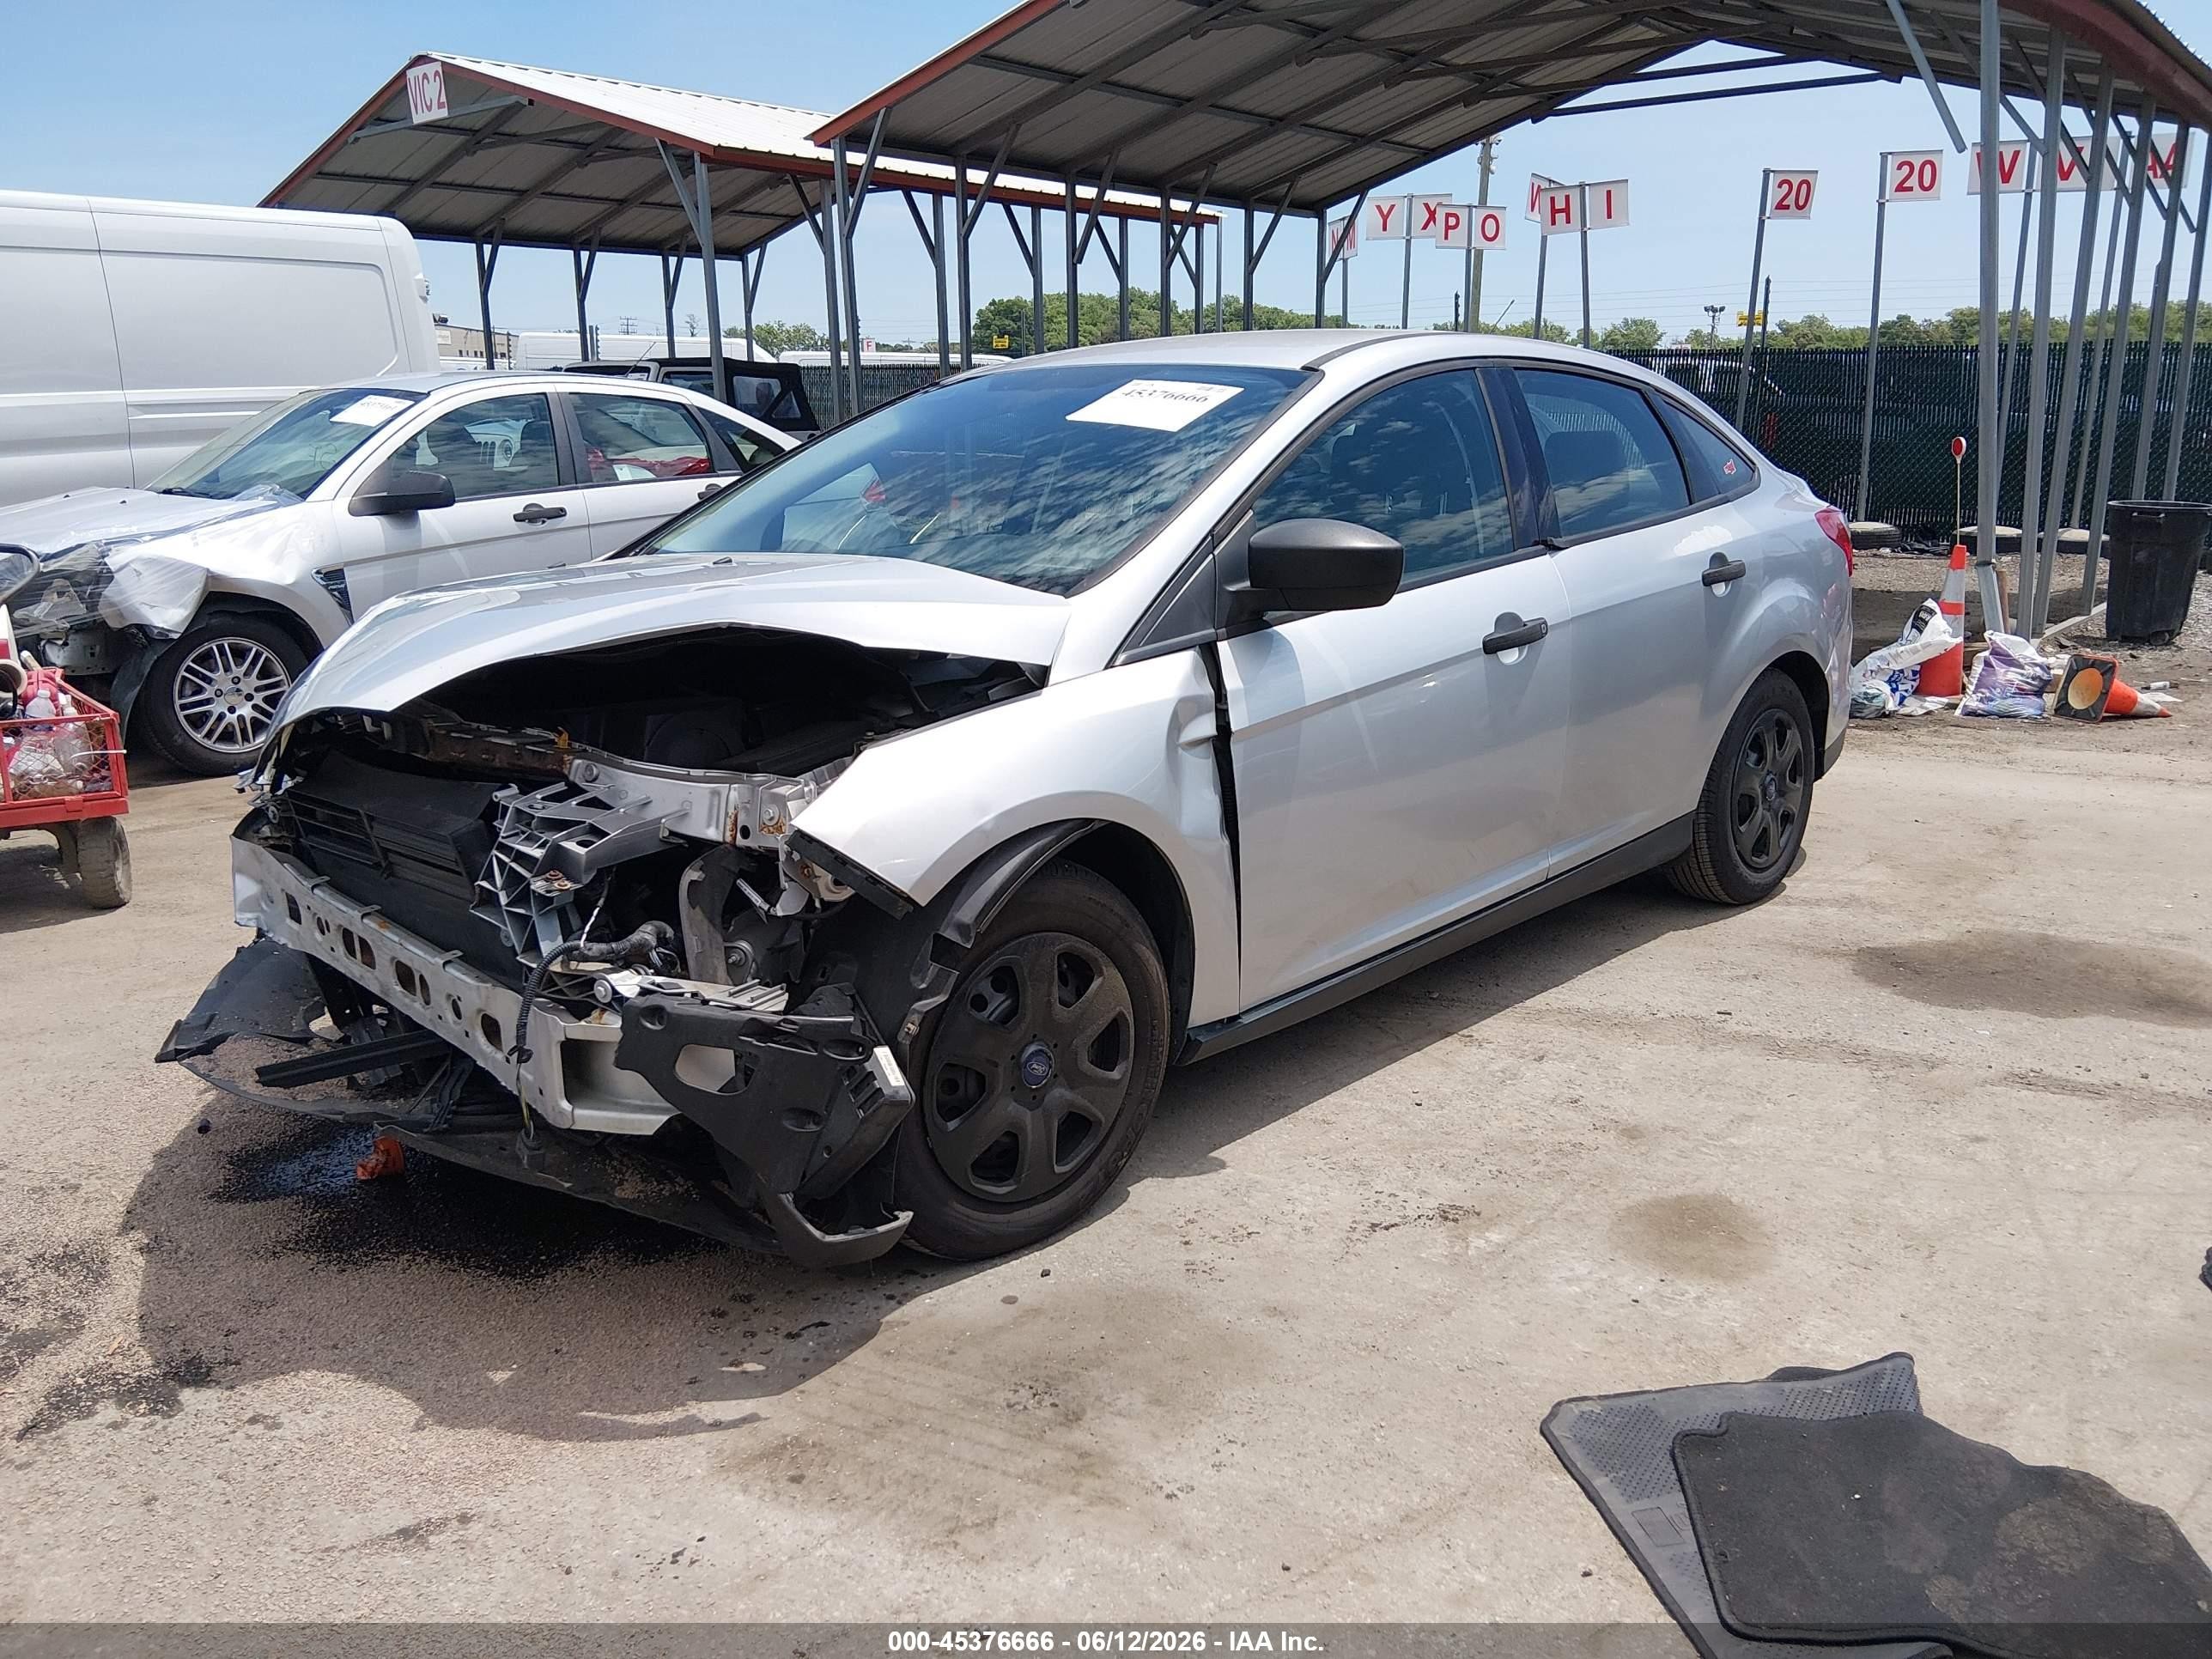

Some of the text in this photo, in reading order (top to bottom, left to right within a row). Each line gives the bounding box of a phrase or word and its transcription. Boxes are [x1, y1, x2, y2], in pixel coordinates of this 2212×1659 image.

[408, 70, 446, 115] VIC 2
[1895, 158, 1938, 193] 20
[1549, 193, 1572, 227] H
[1775, 178, 1813, 211] 20
[1376, 204, 1396, 232] Y
[1421, 202, 1443, 231] X
[1443, 211, 1461, 240] P
[866, 340, 872, 351] F
